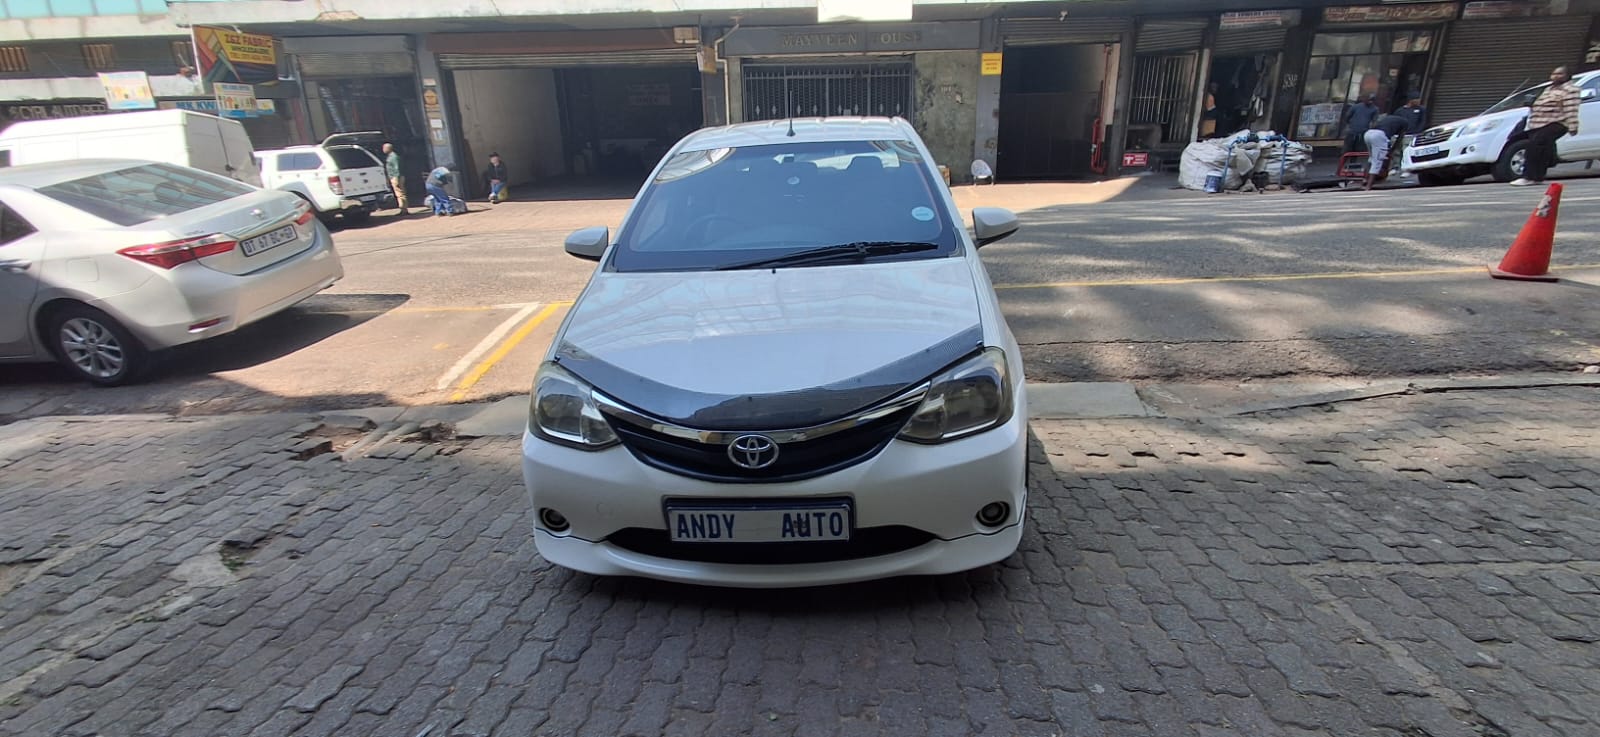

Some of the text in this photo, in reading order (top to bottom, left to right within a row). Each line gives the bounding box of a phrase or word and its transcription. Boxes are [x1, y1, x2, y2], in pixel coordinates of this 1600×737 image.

[873, 31, 921, 45] OUSE
[676, 511, 843, 539] ANDY AUTO
